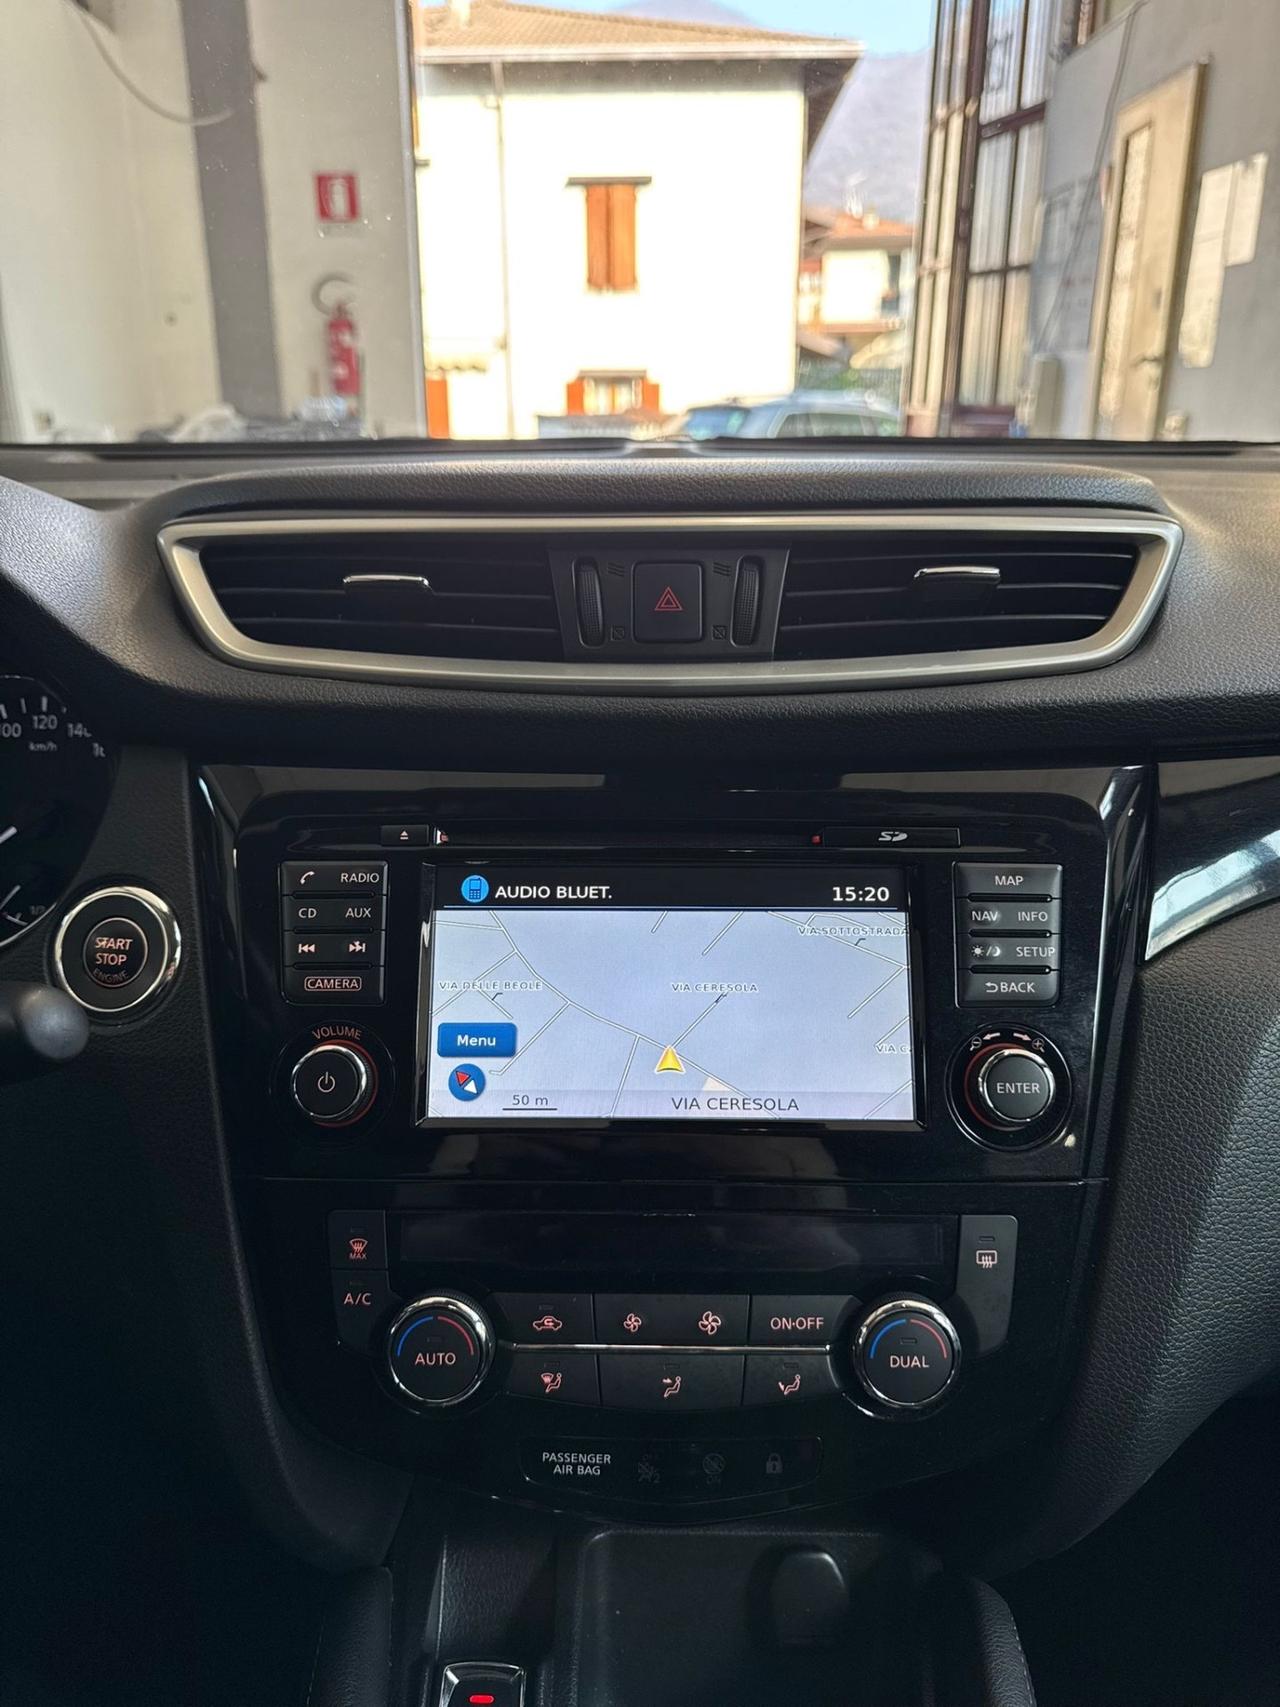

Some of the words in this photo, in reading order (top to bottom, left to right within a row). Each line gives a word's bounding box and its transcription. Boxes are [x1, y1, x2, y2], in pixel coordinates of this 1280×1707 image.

[32, 714, 58, 730] 120
[0, 722, 22, 738] 00
[28, 741, 58, 752] km/h
[340, 872, 380, 883] RADIO
[994, 875, 1024, 886] MAP
[495, 885, 551, 899] AUDIO
[556, 885, 613, 899] BLUET.
[832, 886, 890, 902] 15:20
[298, 908, 317, 919] CD
[345, 907, 372, 918] AUX
[971, 911, 999, 922] NAV
[1017, 911, 1048, 922] INFO
[94, 936, 133, 951] START
[1015, 946, 1055, 957] SETUP
[95, 952, 127, 966] STOP
[92, 967, 129, 984] ENGINE
[307, 979, 359, 989] CAMERA
[439, 981, 458, 990] VIA
[463, 981, 499, 990] DELLE
[671, 983, 691, 992] VIA
[694, 983, 758, 992] CERESOLA
[1000, 982, 1036, 993] BACK
[312, 1026, 363, 1041] VOLUME
[456, 1034, 496, 1047] Menu
[875, 1044, 896, 1053] VIA
[996, 1082, 1041, 1094] ENTER
[512, 1094, 530, 1106] 50
[534, 1096, 549, 1106] m
[671, 1097, 701, 1111] VIA
[706, 1097, 799, 1111] CERESOLA
[349, 1252, 367, 1260] MAX
[343, 1292, 372, 1306] A/C
[414, 1352, 456, 1365] AUTO
[889, 1355, 930, 1368] DUAL
[542, 1451, 611, 1464] PASSENGER
[553, 1464, 574, 1475] AIR
[577, 1464, 601, 1476] BAG
